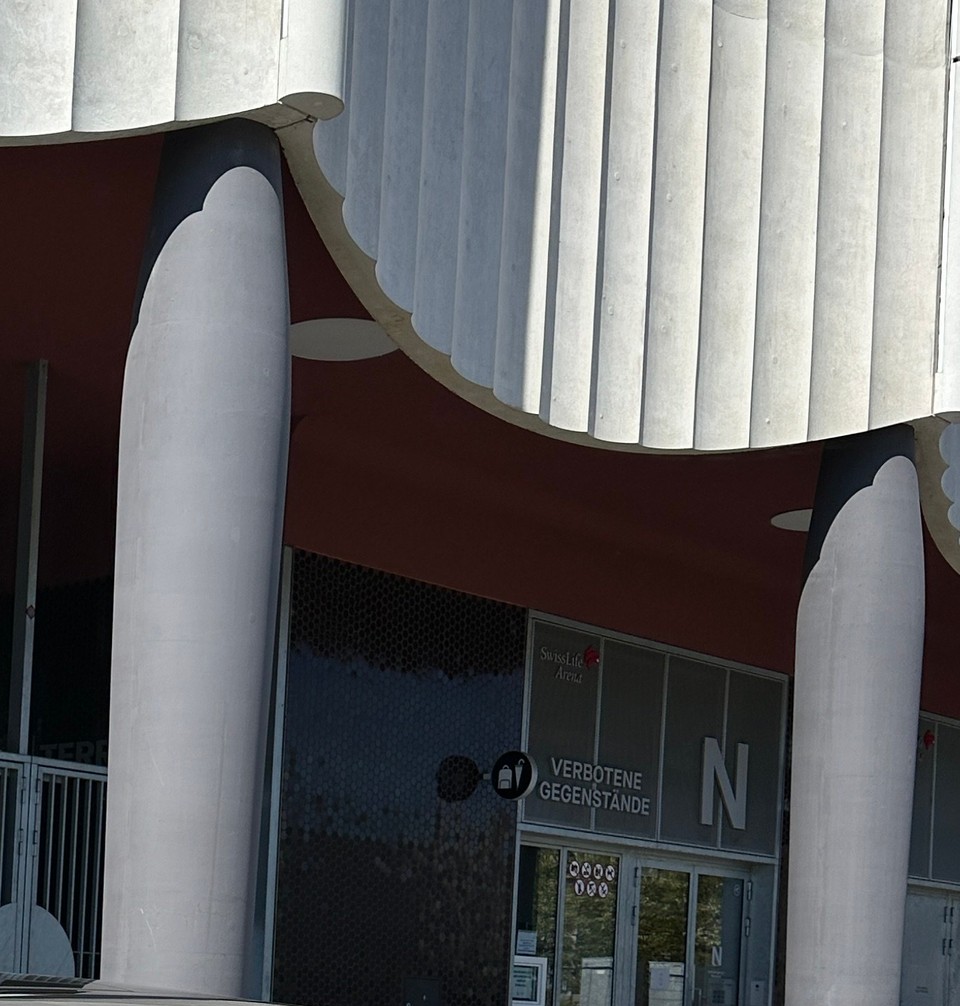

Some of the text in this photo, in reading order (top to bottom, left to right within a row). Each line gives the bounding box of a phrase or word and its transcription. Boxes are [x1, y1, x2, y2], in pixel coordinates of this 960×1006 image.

[555, 666, 583, 684] Arena
[551, 757, 642, 790] VERBOTENE
[700, 736, 749, 830] N
[540, 781, 650, 815] GEGENSTÄNDE
[711, 946, 723, 966] N
